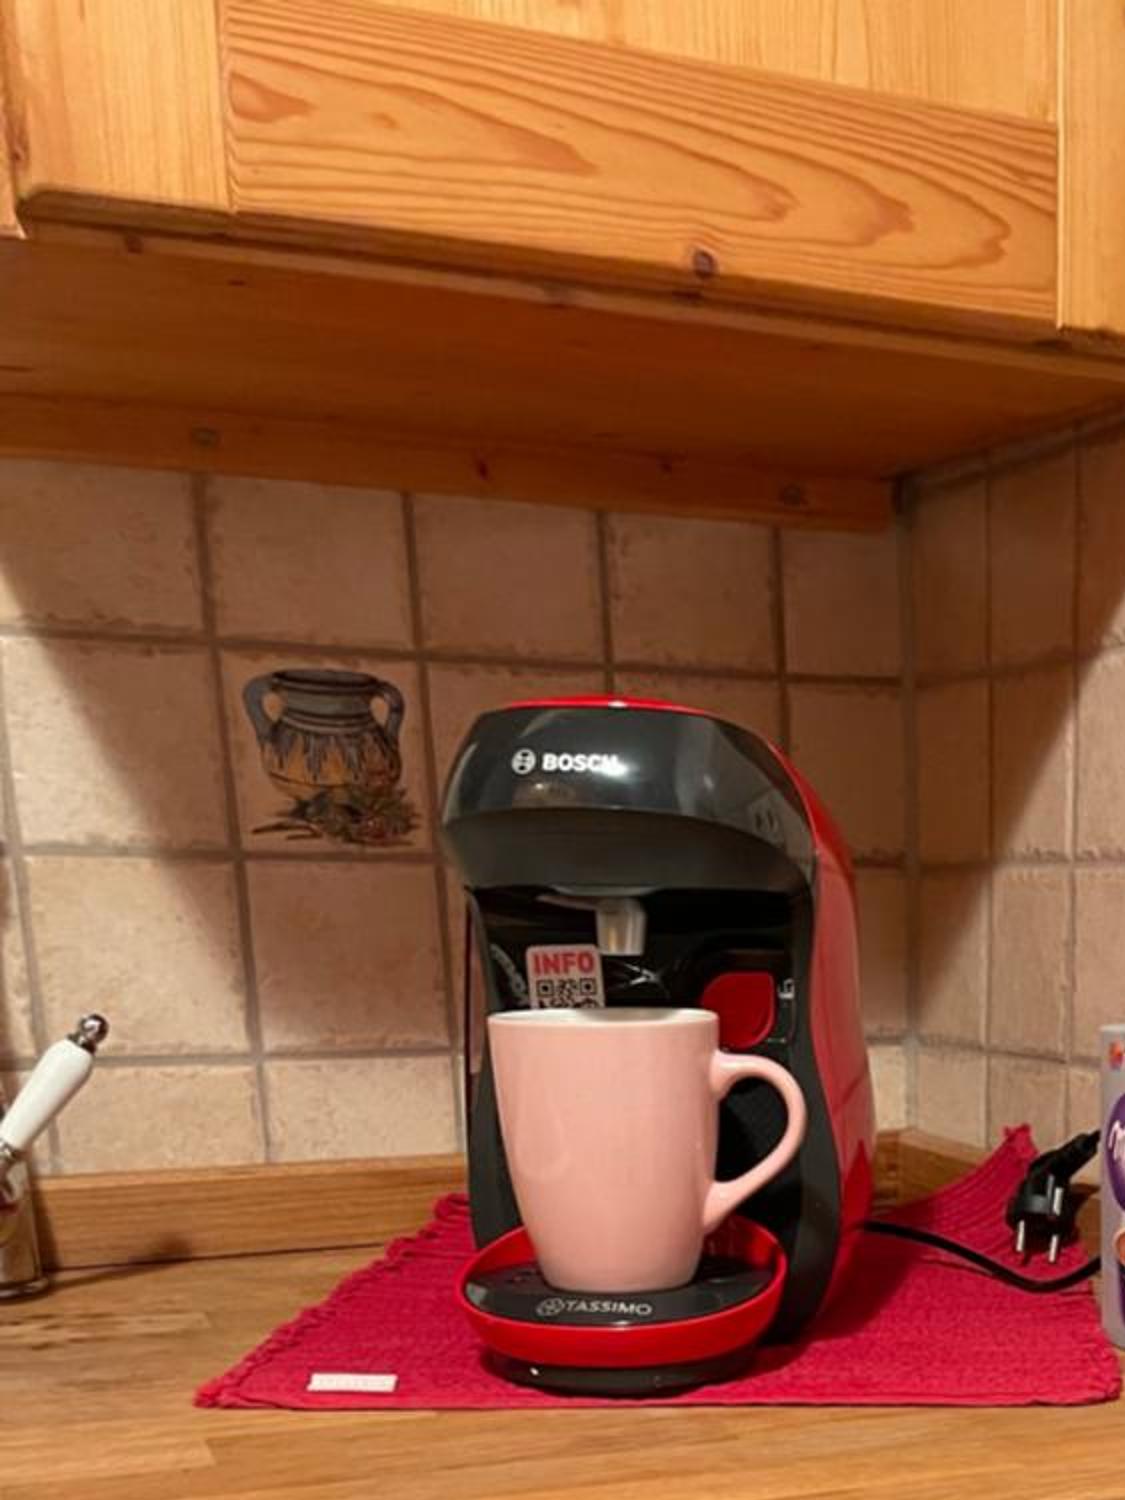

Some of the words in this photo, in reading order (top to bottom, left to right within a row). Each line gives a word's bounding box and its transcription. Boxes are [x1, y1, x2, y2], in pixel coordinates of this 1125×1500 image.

[542, 753, 620, 773] BOSCH
[533, 951, 595, 975] INFO
[565, 1300, 654, 1316] TASSIMO
